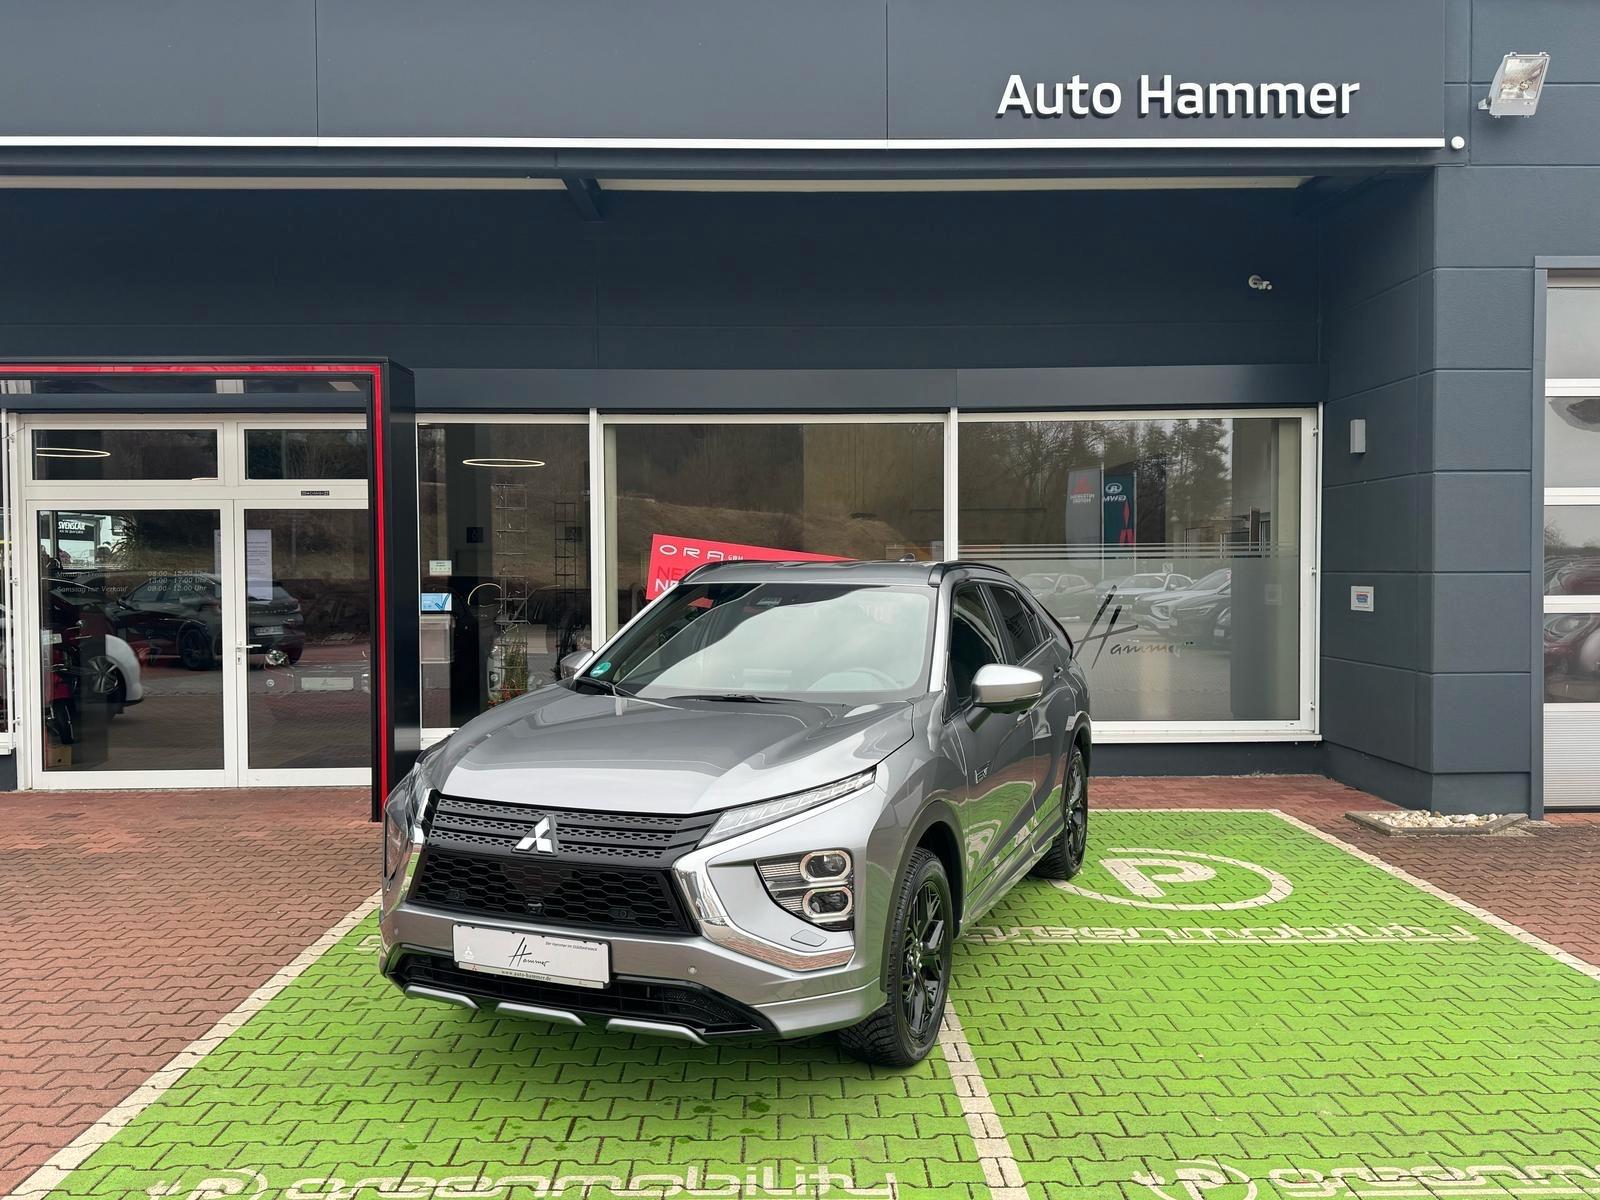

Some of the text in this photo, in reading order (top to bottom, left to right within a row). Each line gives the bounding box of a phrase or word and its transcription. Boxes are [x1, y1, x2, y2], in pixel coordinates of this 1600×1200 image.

[996, 74, 1360, 117] Auto Hammer
[660, 544, 723, 561] ORA
[1268, 1164, 1600, 1198] greenm
